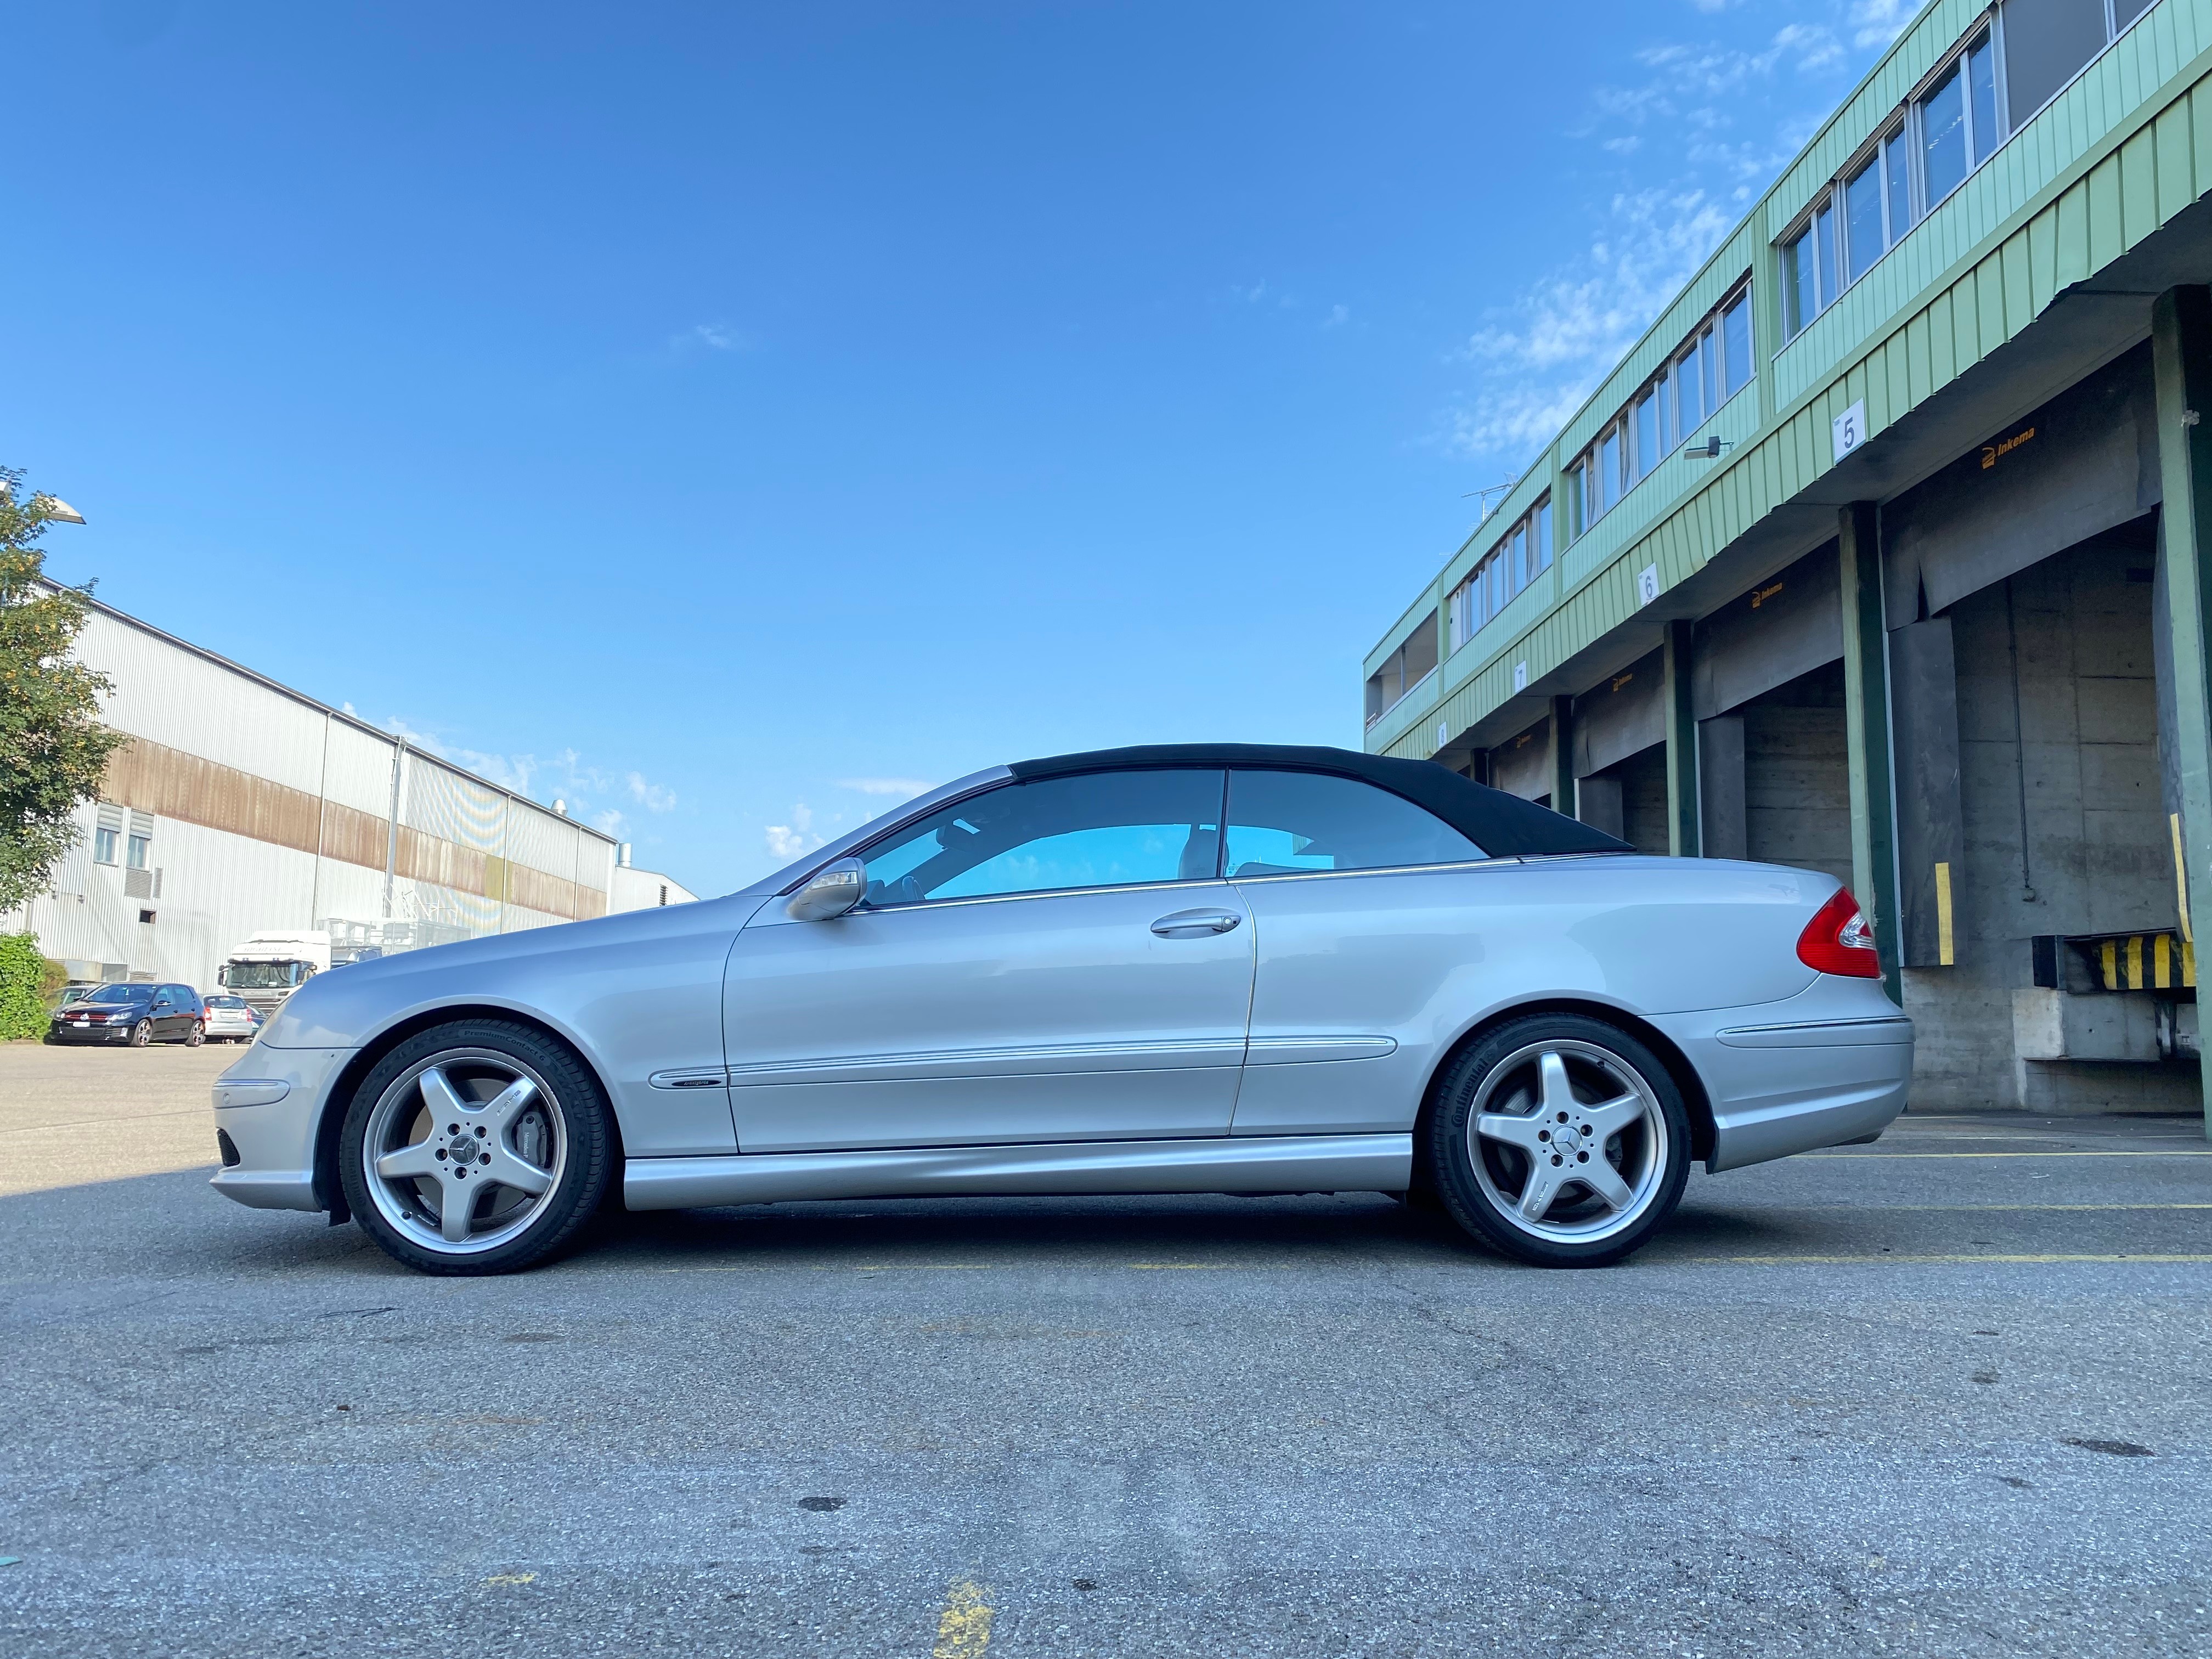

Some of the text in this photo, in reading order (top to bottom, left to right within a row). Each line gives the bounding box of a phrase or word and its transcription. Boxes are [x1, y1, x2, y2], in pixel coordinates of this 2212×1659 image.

[1844, 416, 1855, 449] 5
[1997, 427, 2034, 456] Inkema
[1646, 575, 1652, 597] 6
[1519, 669, 1523, 688] 7
[1441, 729, 1444, 744] 8
[464, 1030, 538, 1056] PremiumContact
[1451, 1057, 1489, 1128] Continental
